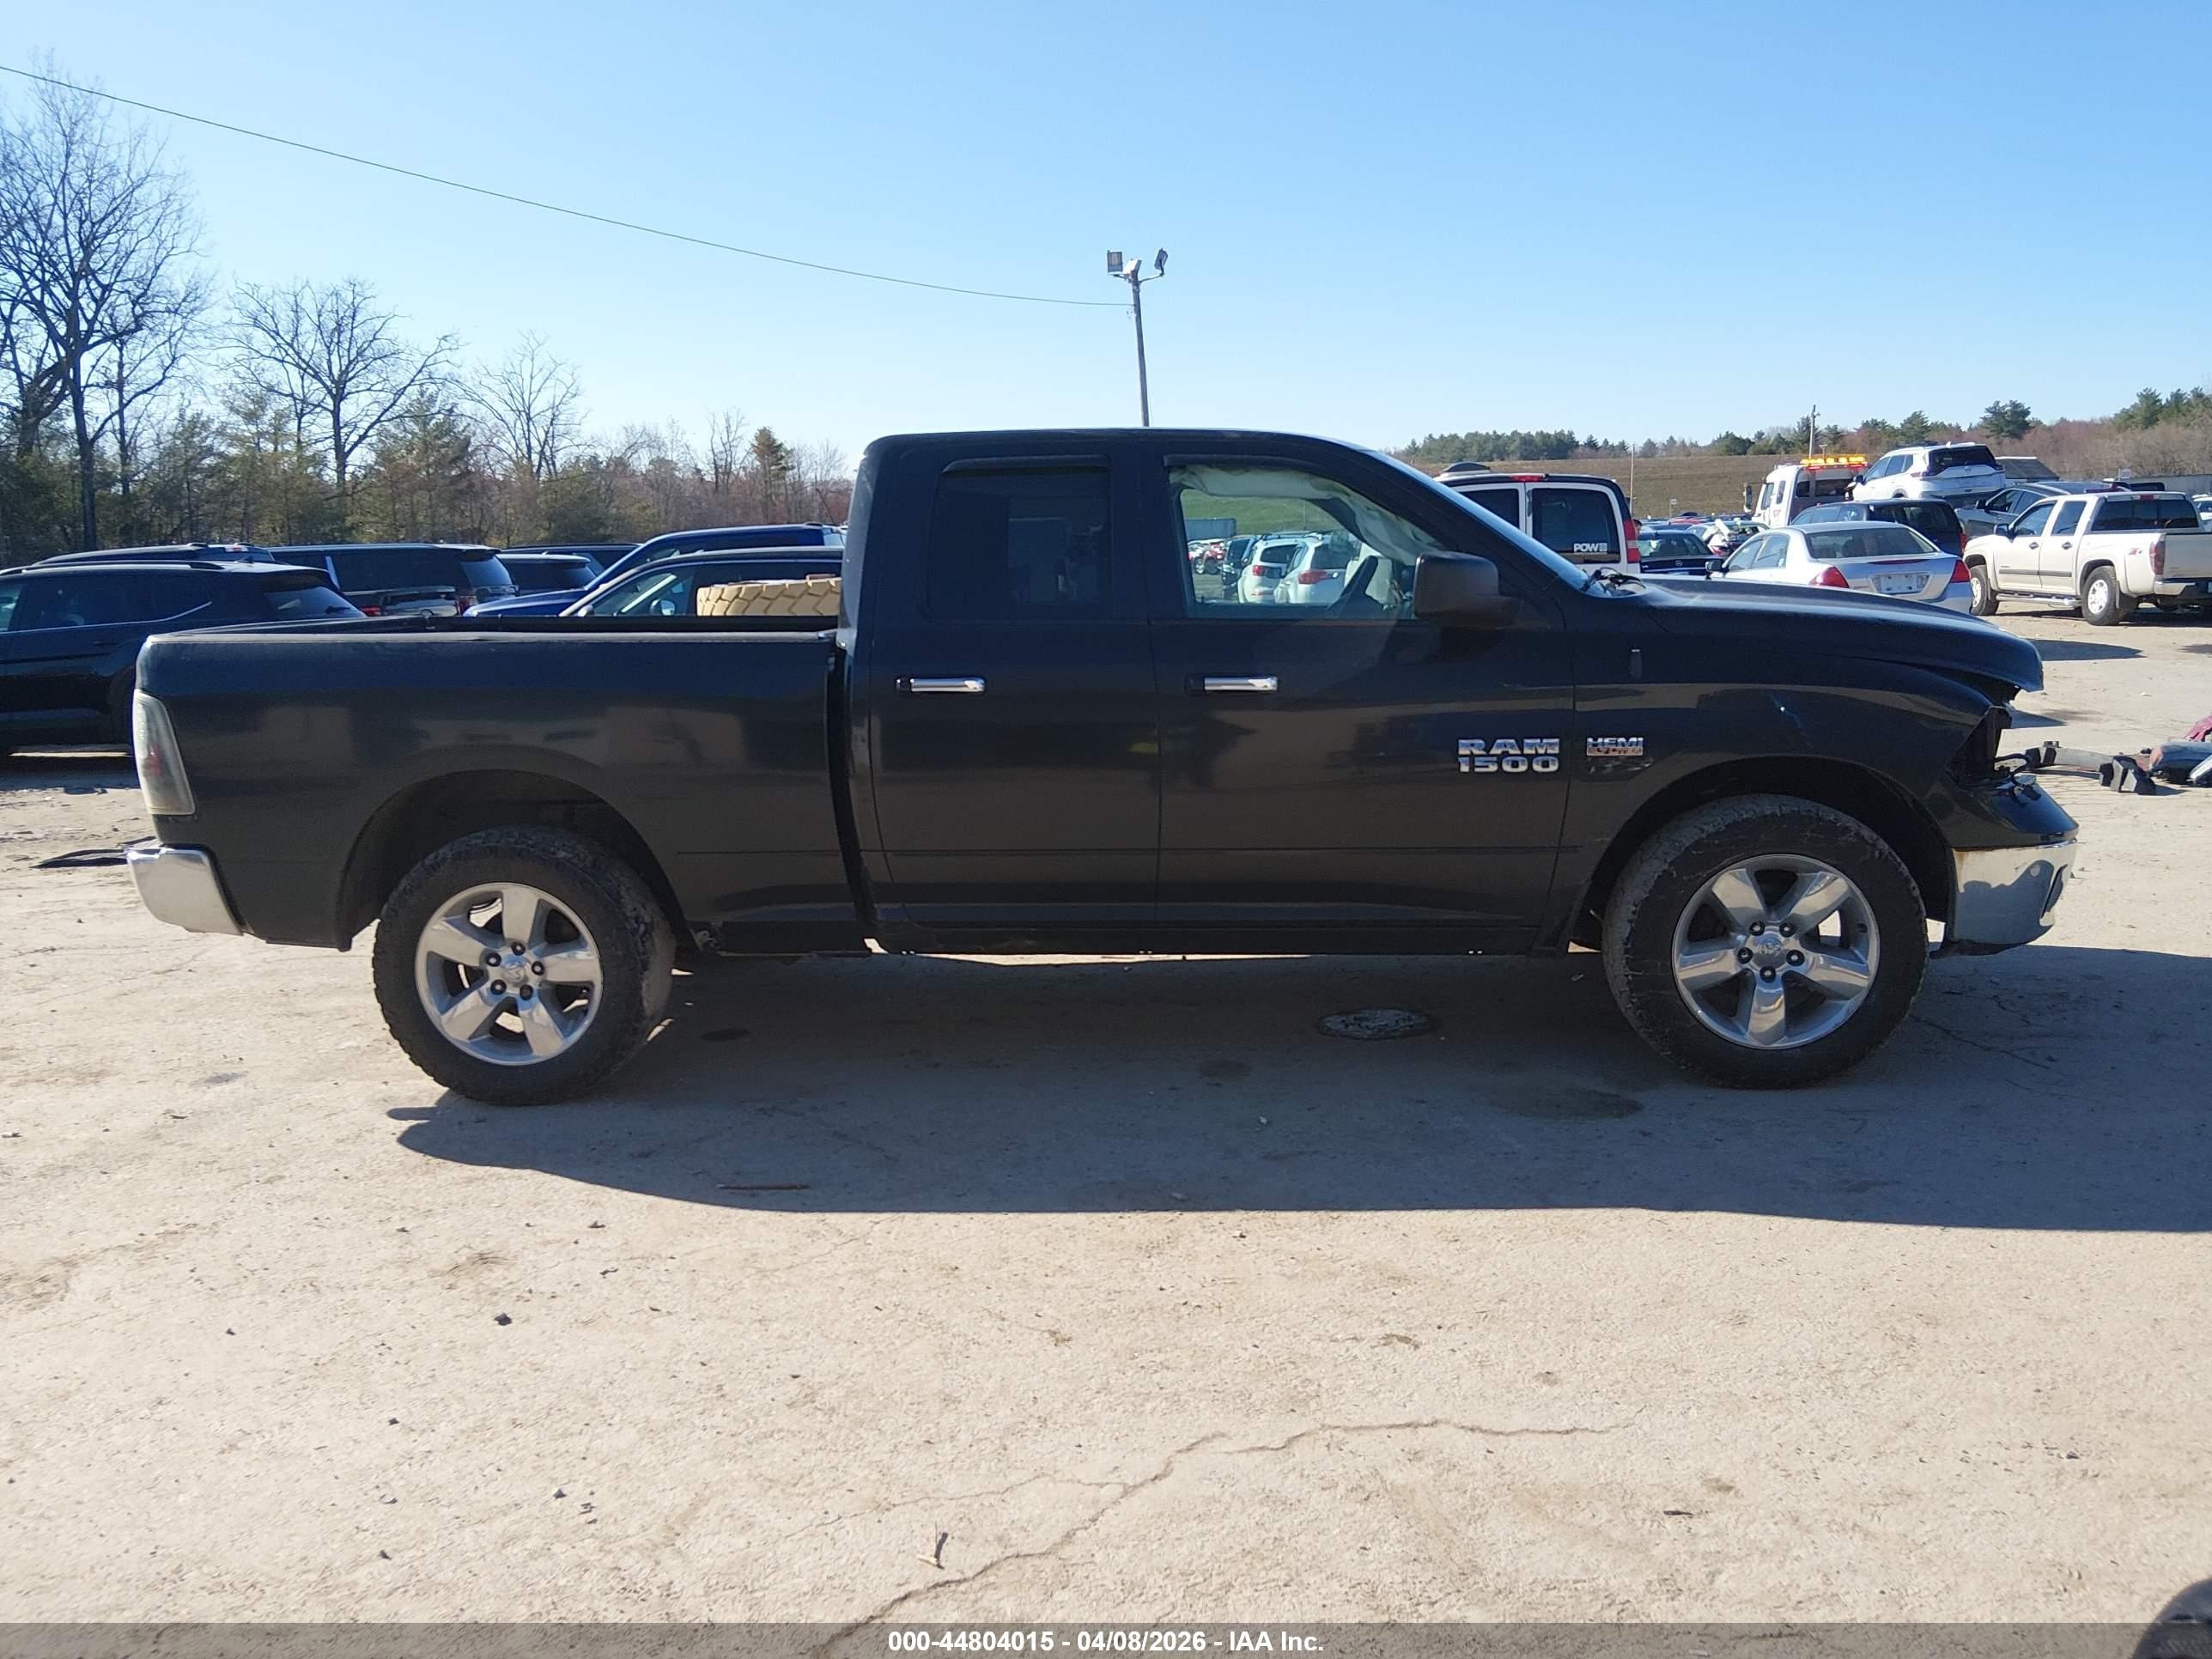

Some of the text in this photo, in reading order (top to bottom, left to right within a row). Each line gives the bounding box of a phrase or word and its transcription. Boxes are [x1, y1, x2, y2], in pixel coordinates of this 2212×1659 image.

[1458, 738, 1559, 755] RAM
[1586, 738, 1644, 747] HEMI
[1457, 756, 1559, 772] 1500
